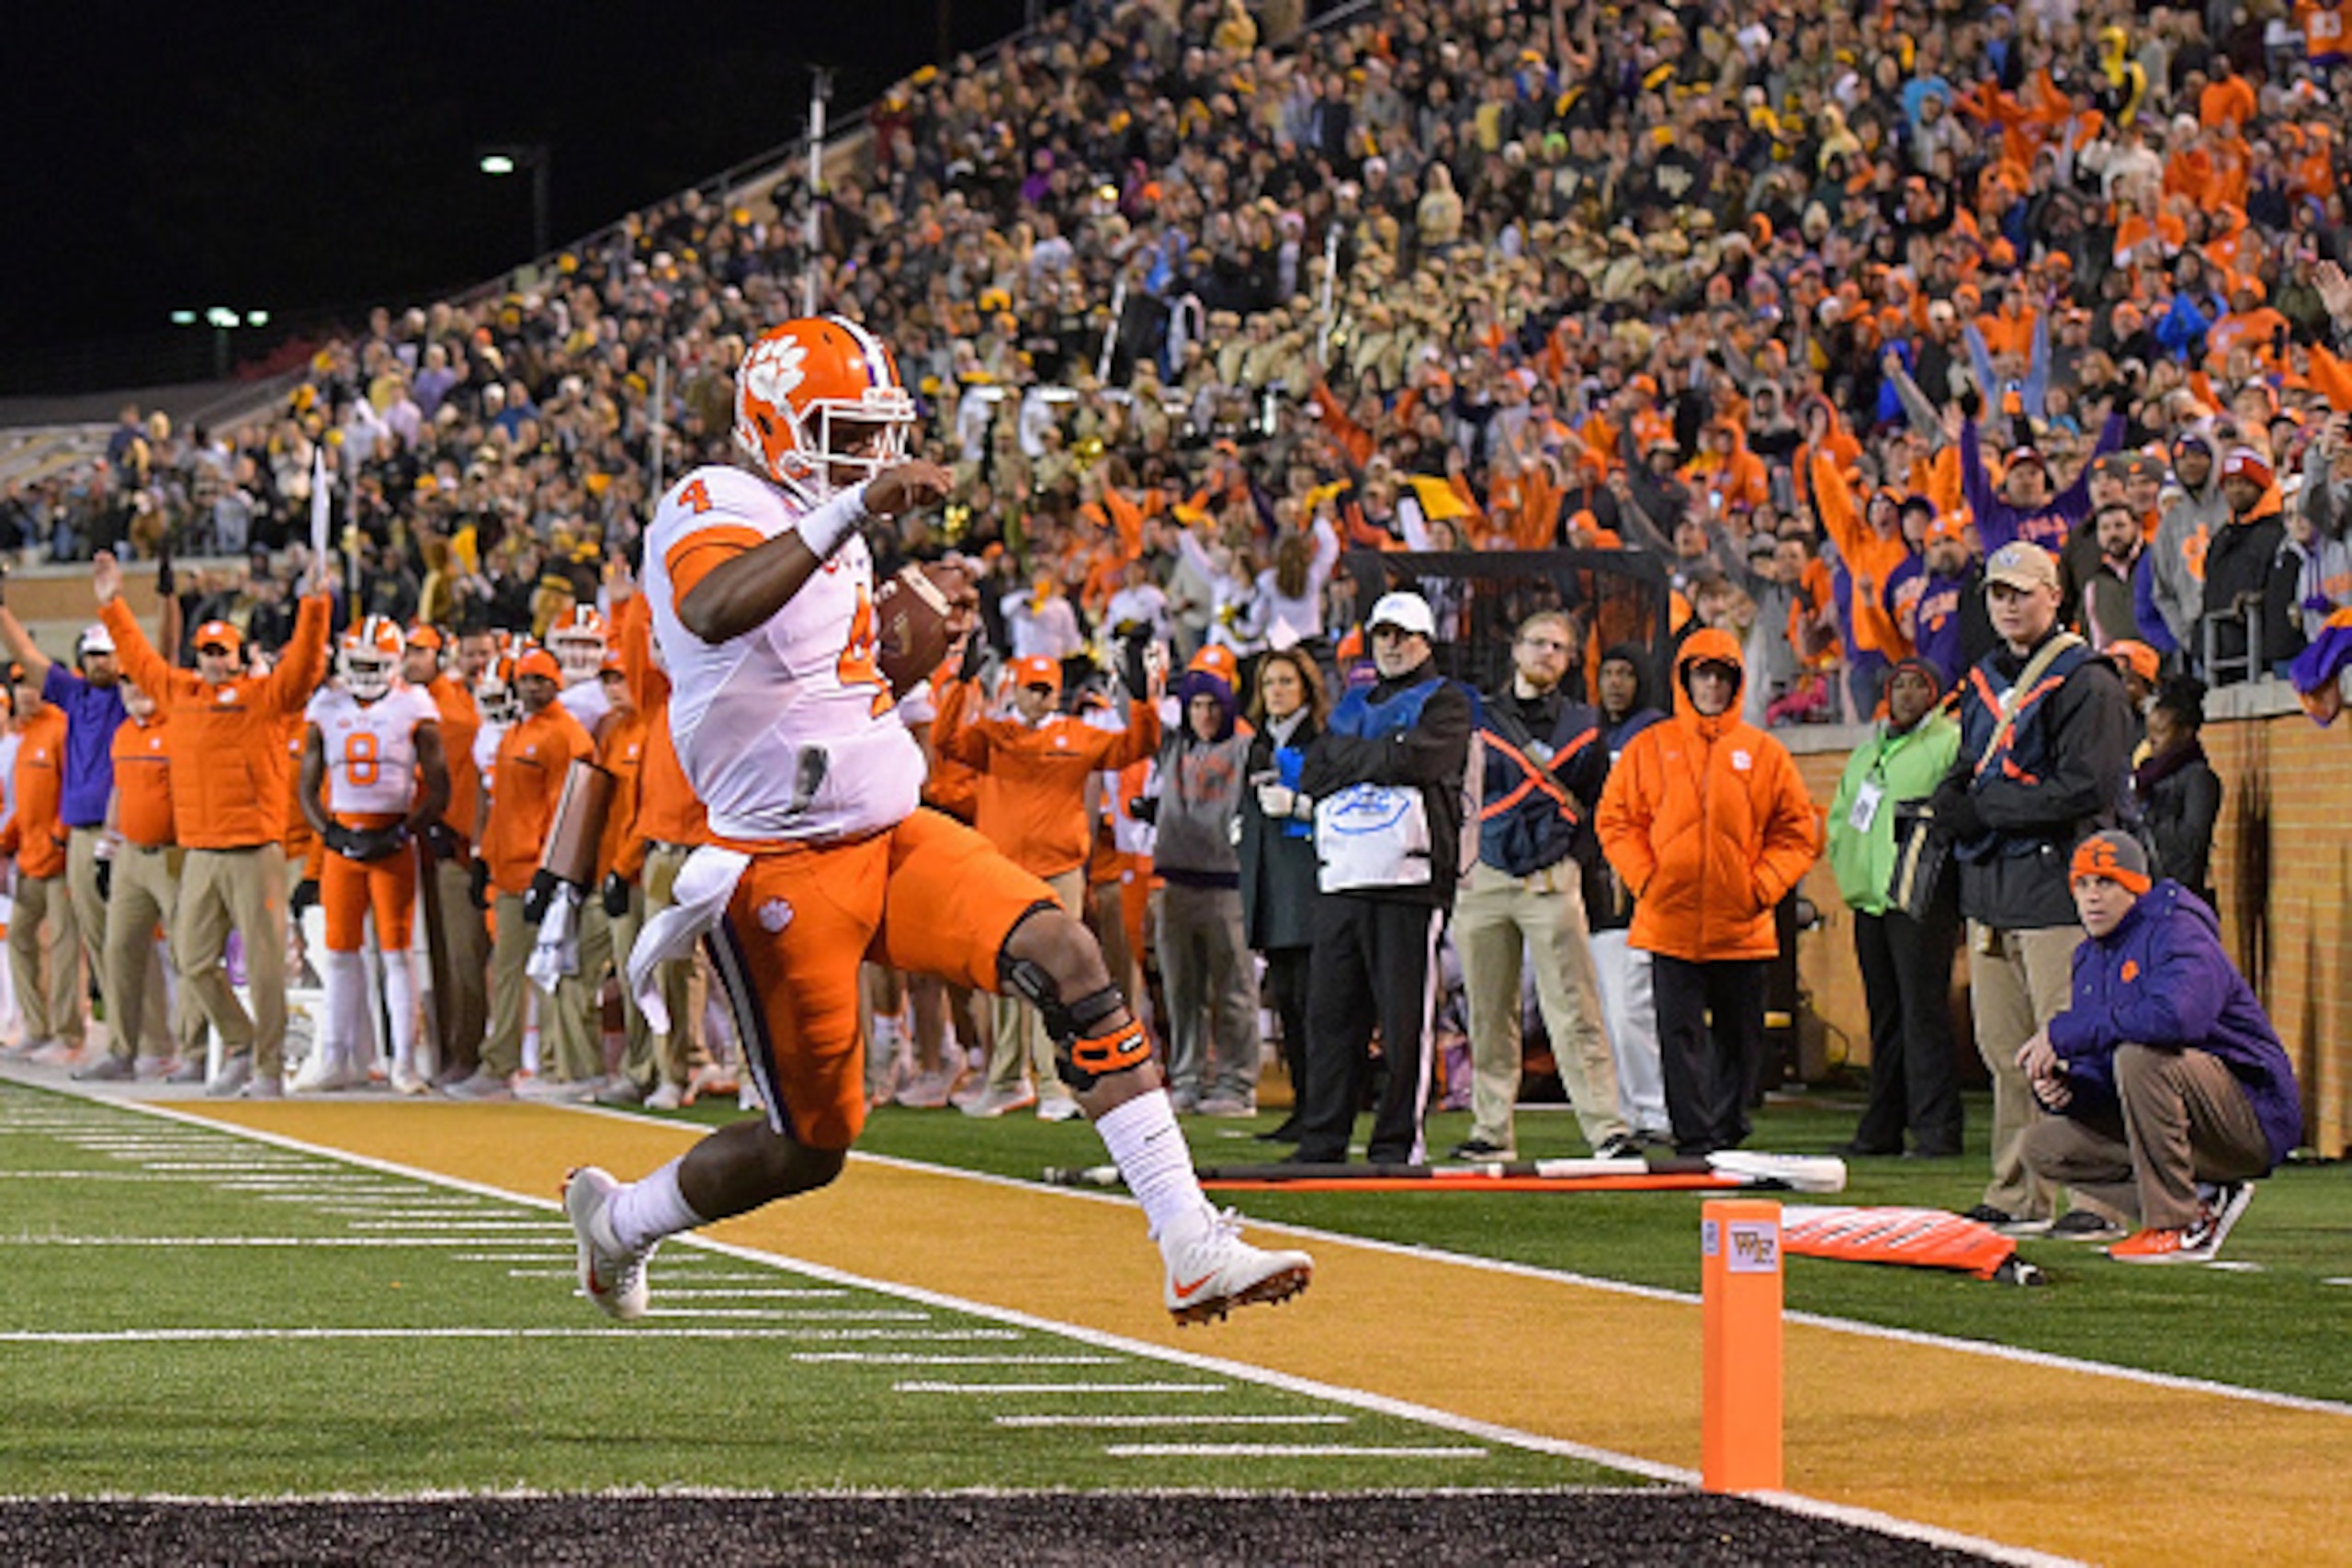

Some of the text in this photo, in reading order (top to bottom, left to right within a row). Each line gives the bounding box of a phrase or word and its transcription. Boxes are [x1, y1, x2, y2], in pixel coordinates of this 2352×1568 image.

[677, 479, 712, 514] 4
[837, 581, 897, 720] 4
[344, 731, 379, 787] 8
